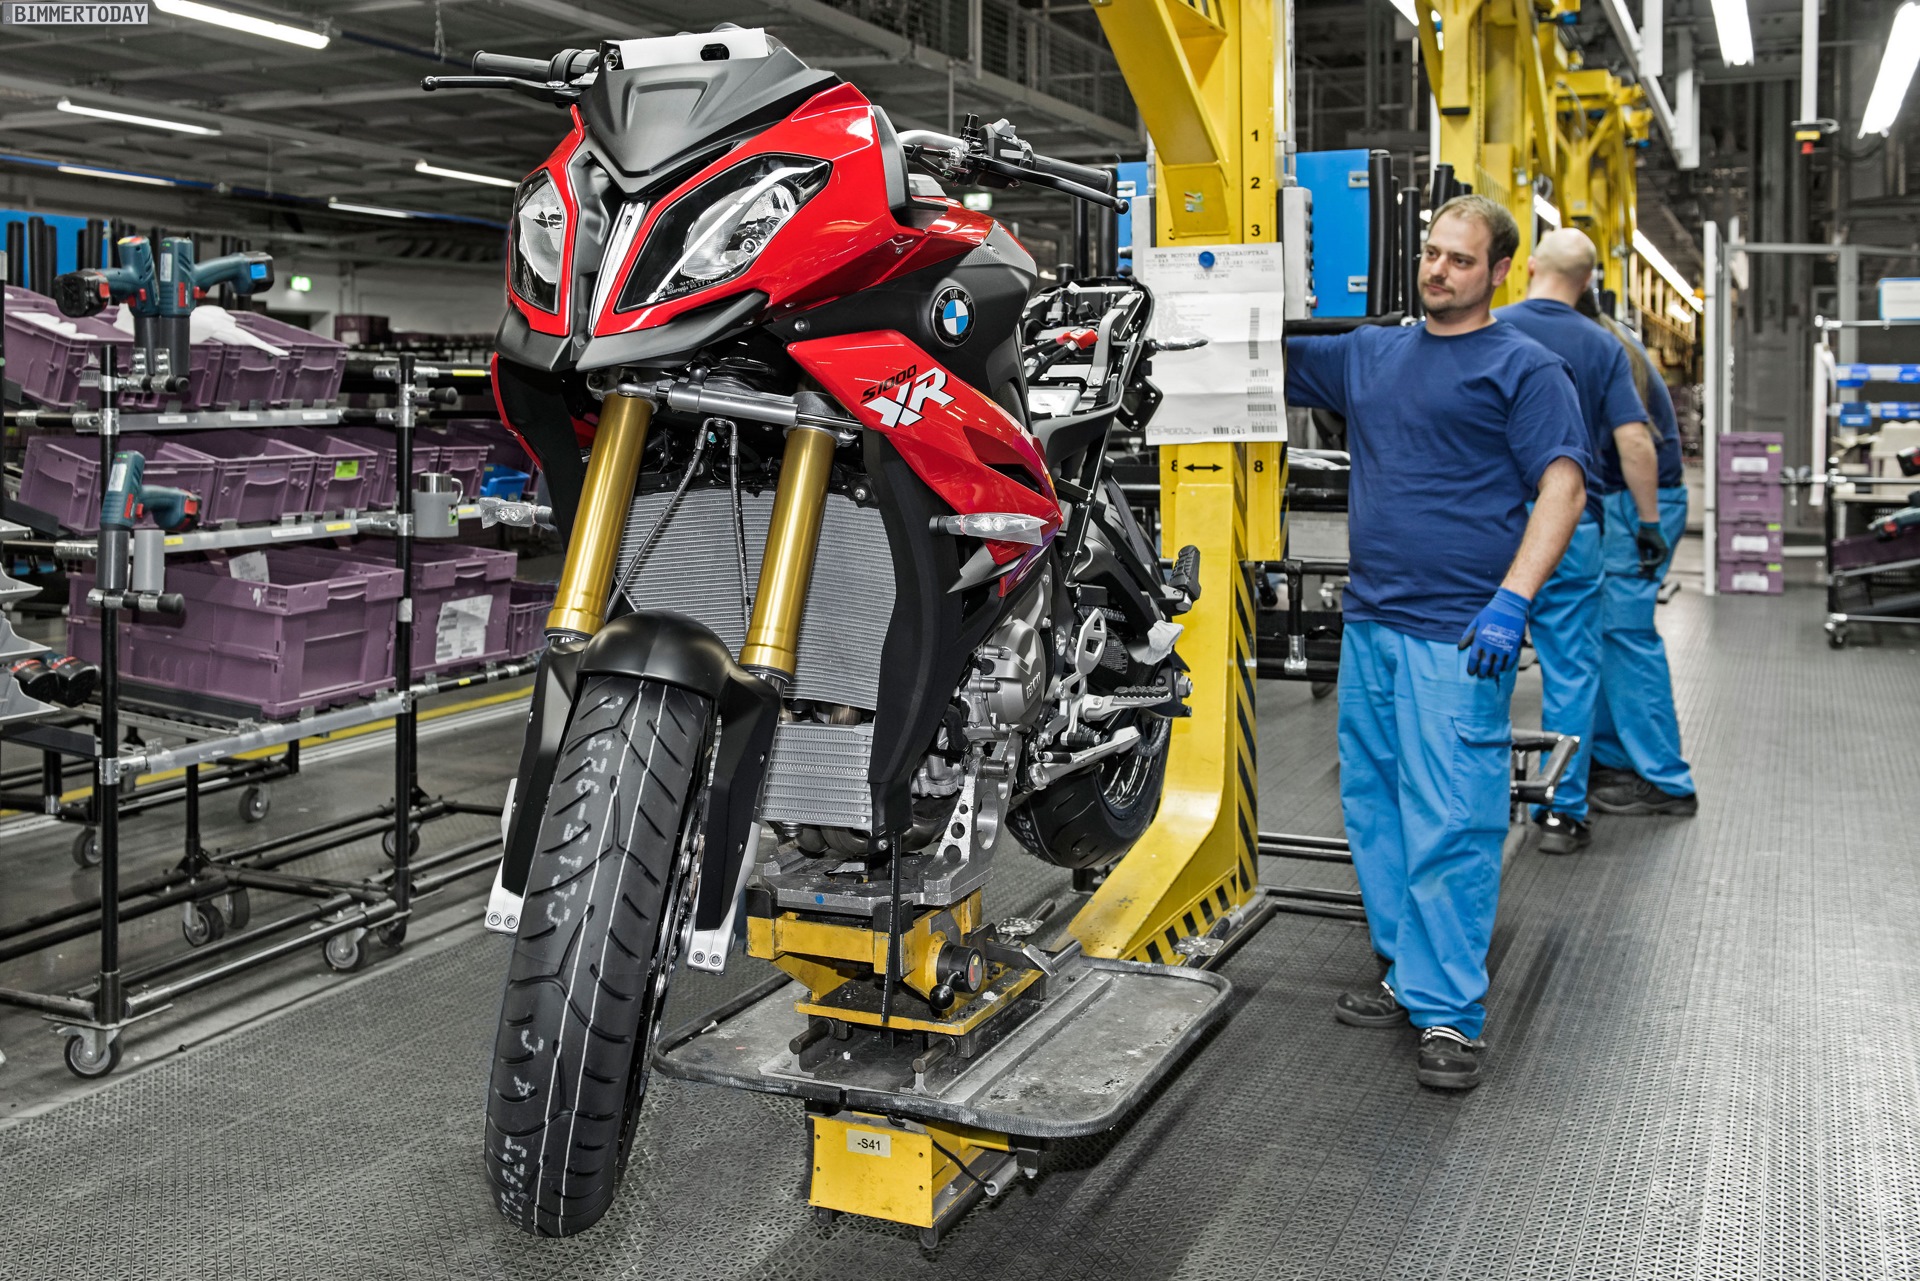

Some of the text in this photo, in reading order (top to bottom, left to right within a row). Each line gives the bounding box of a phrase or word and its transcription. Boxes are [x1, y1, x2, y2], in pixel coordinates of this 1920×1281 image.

[1251, 129, 1259, 142] 1
[1251, 176, 1260, 189] 2
[1251, 223, 1261, 237] 3
[937, 289, 972, 311] BMW
[862, 364, 917, 402] S1000
[863, 367, 957, 428] XR
[1253, 460, 1264, 473] 8
[857, 1138, 881, 1151] -S41
